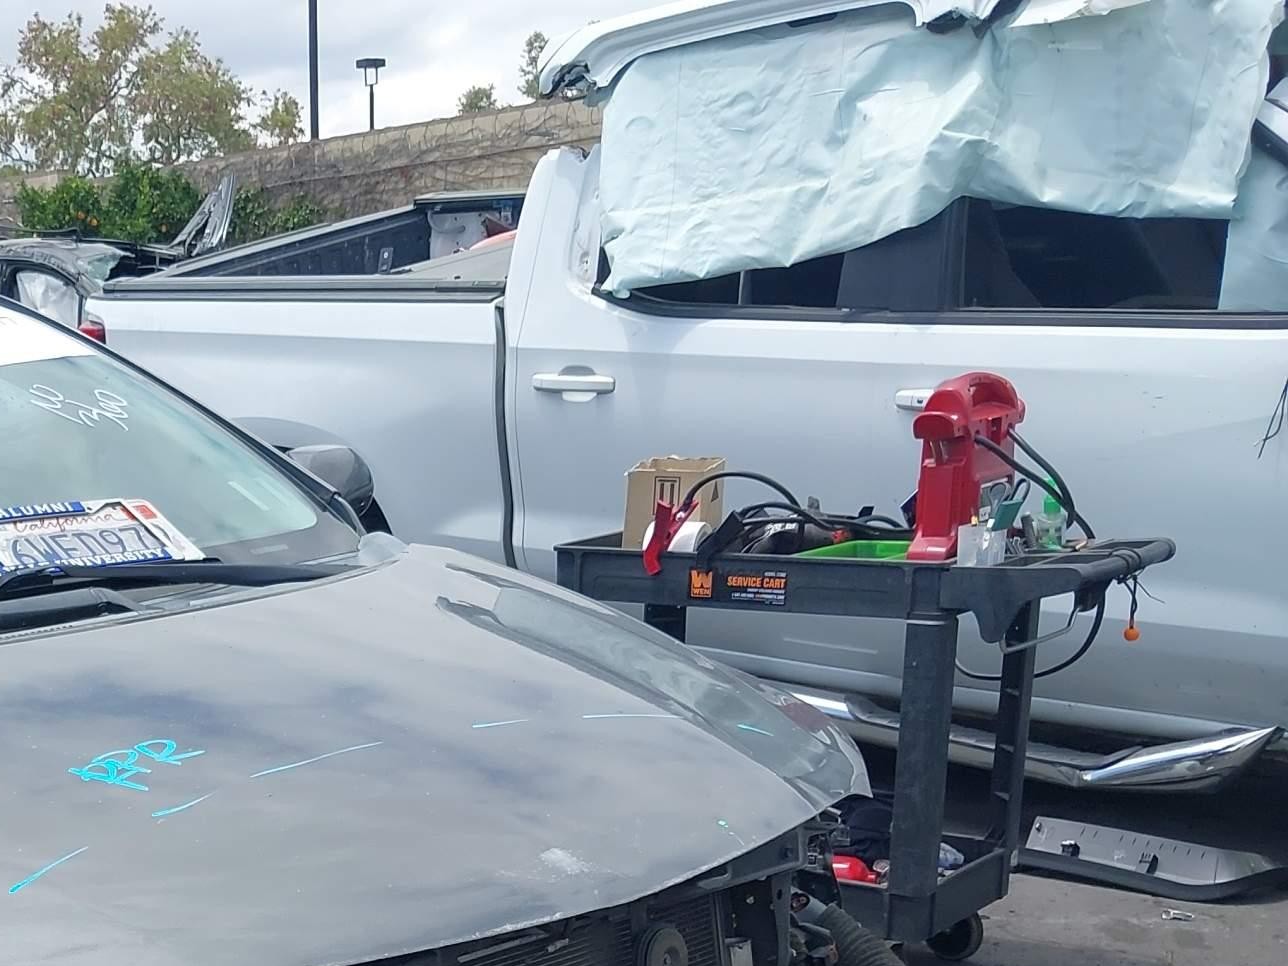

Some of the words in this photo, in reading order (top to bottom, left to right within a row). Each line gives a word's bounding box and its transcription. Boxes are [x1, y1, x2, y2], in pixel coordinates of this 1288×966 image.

[13, 513, 114, 533] California
[727, 576, 762, 588] SERVICE
[762, 578, 787, 589] CART
